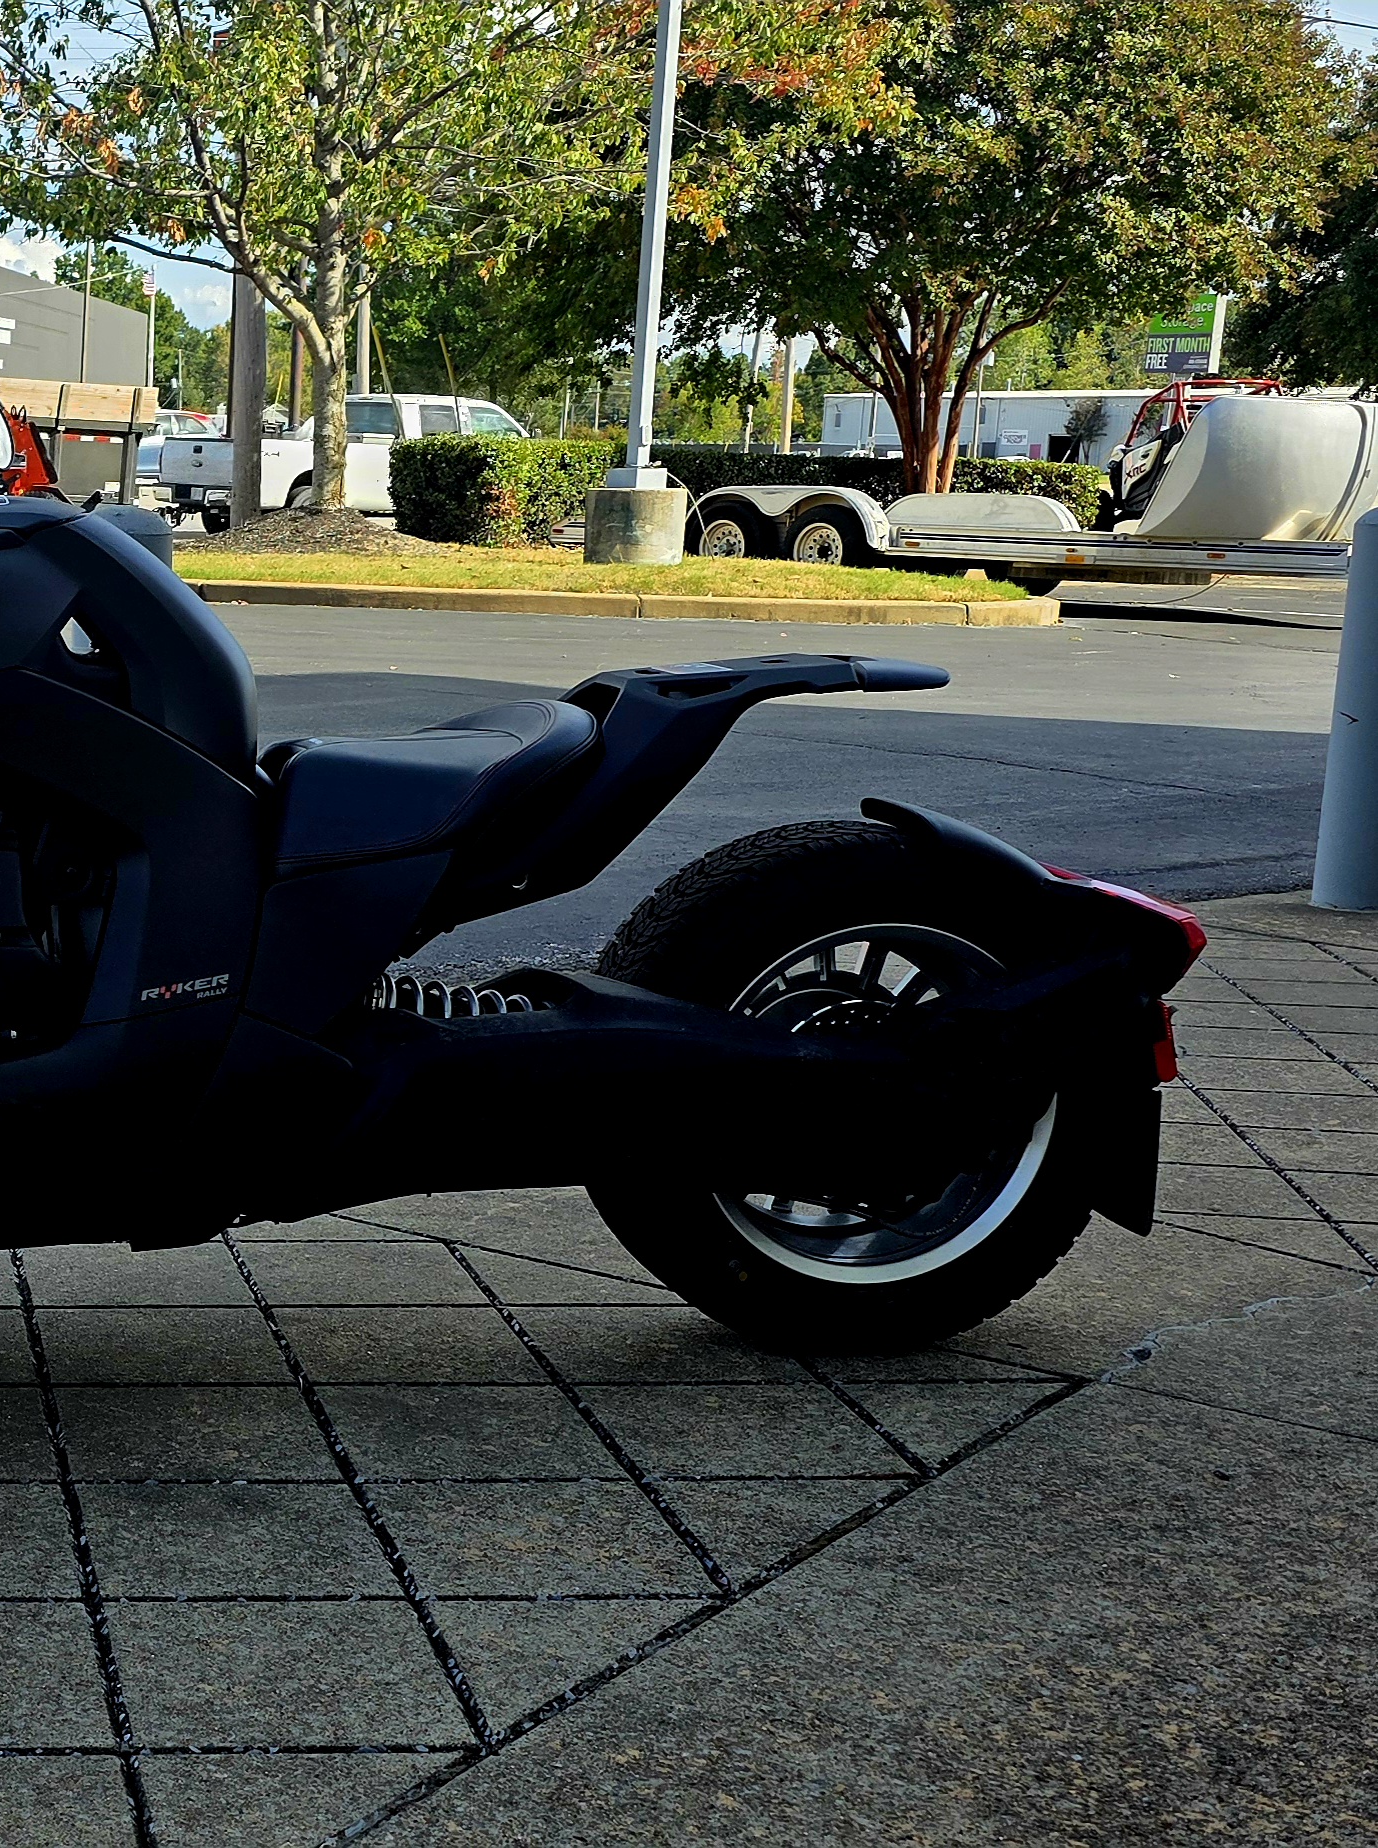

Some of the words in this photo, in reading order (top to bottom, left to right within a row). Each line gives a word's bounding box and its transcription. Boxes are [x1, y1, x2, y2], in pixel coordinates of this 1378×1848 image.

[1147, 337, 1175, 353] FIRST
[1175, 336, 1211, 353] MONTH
[1145, 354, 1169, 370] FREE
[140, 973, 230, 1001] RYKER
[196, 987, 228, 999] RALLY
